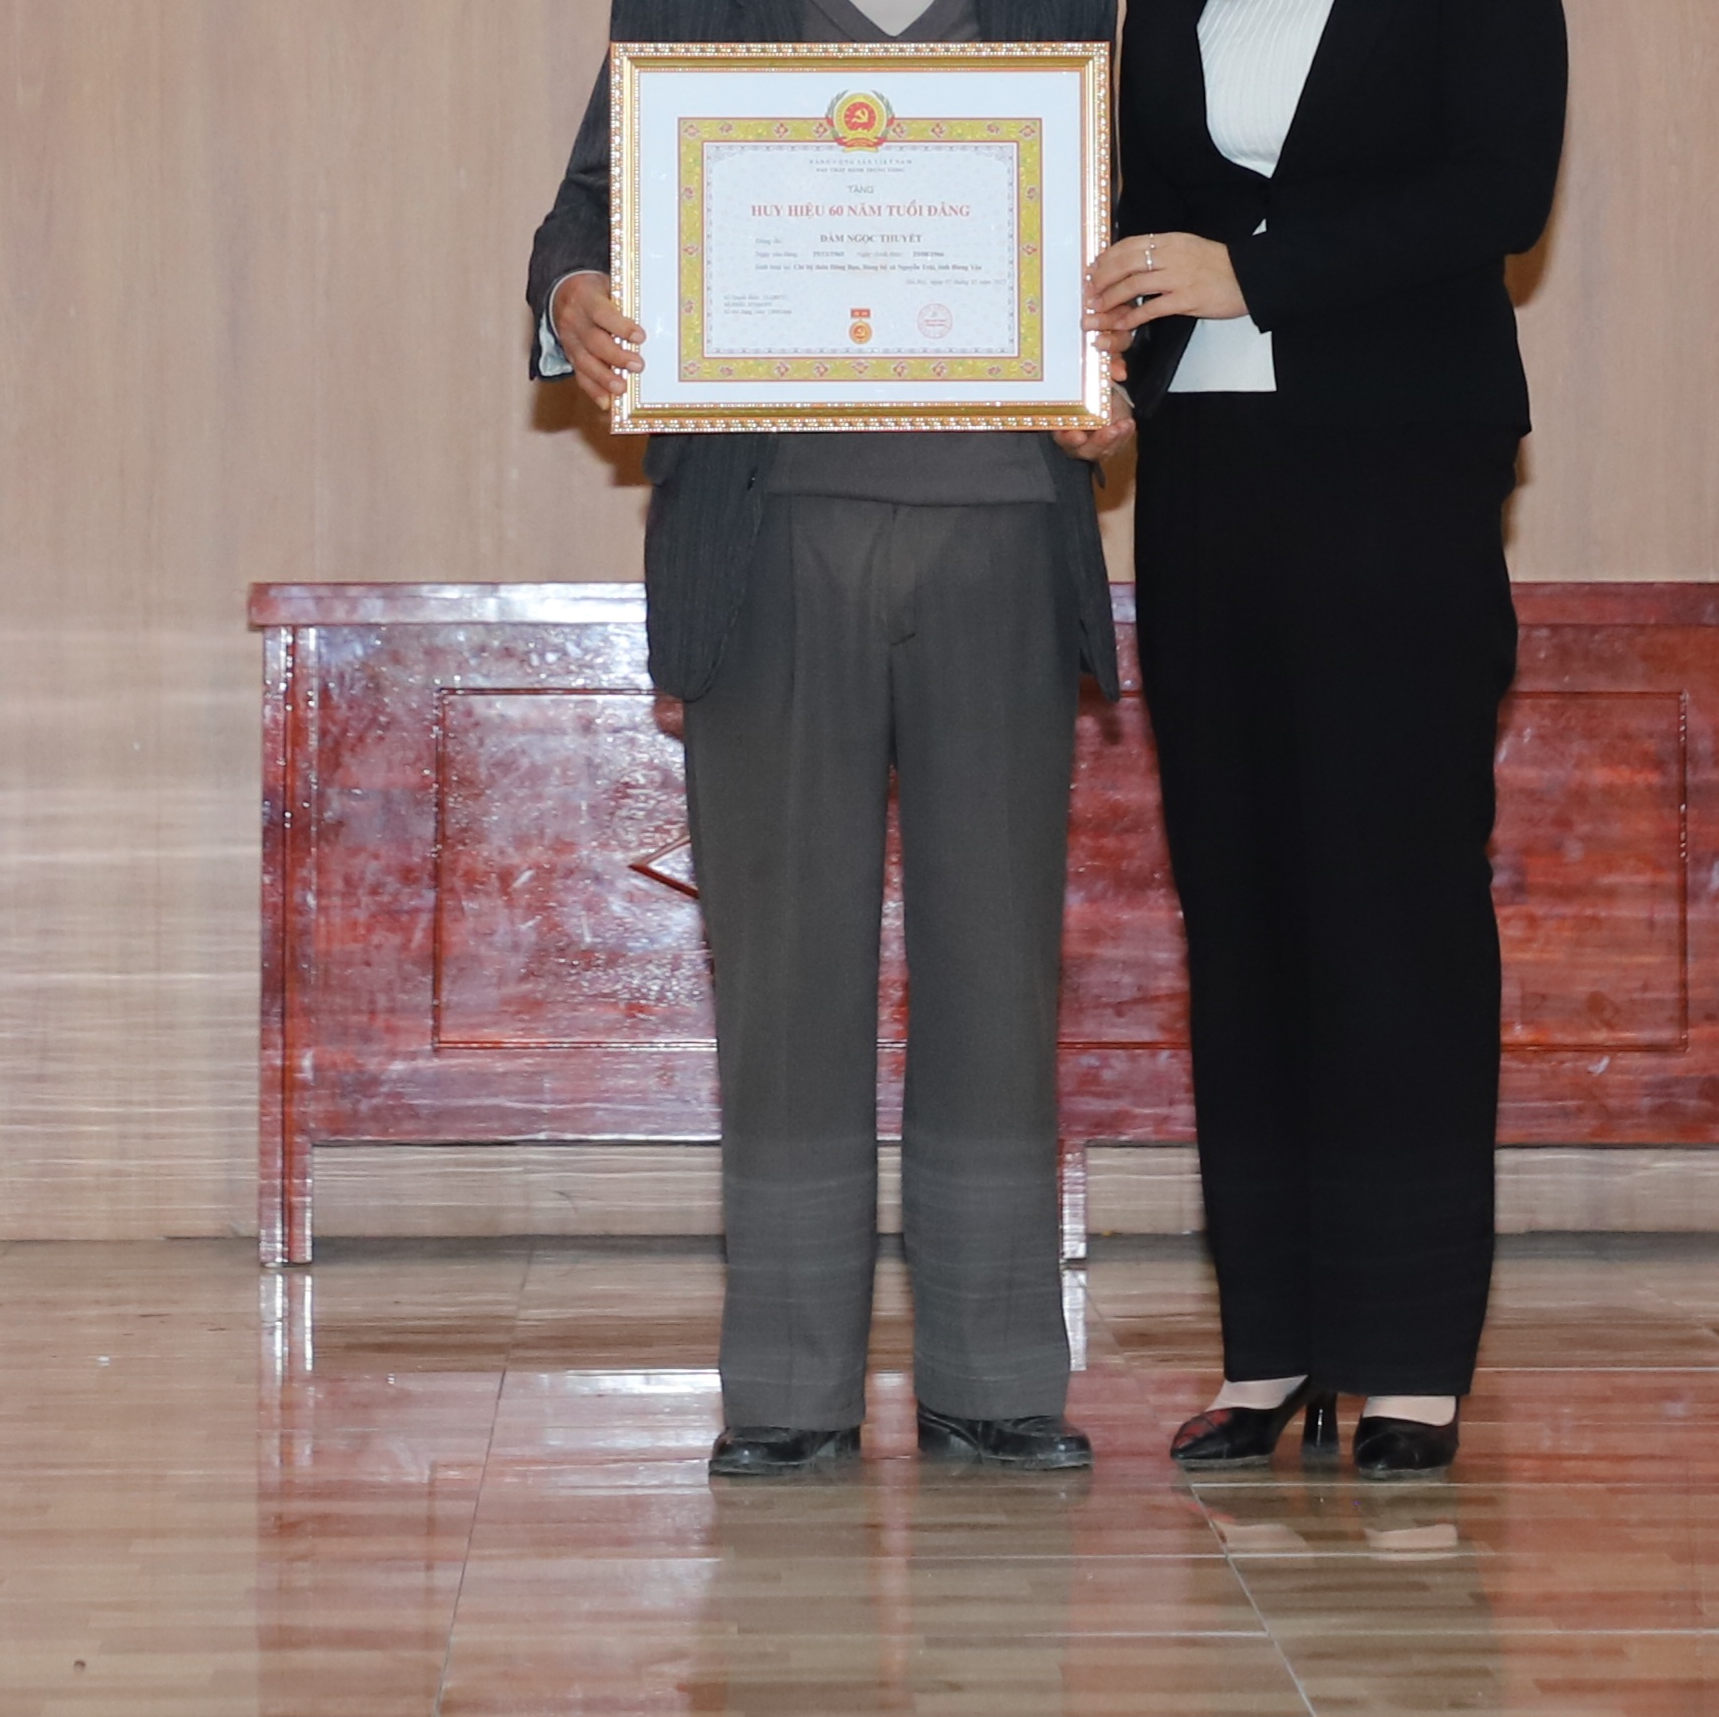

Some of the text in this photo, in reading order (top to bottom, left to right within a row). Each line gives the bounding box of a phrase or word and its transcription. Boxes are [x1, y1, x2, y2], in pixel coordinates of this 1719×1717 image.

[750, 204, 783, 217] HUY
[788, 201, 825, 219] HIỆU
[828, 204, 844, 217] 60
[847, 202, 883, 217] NĂM
